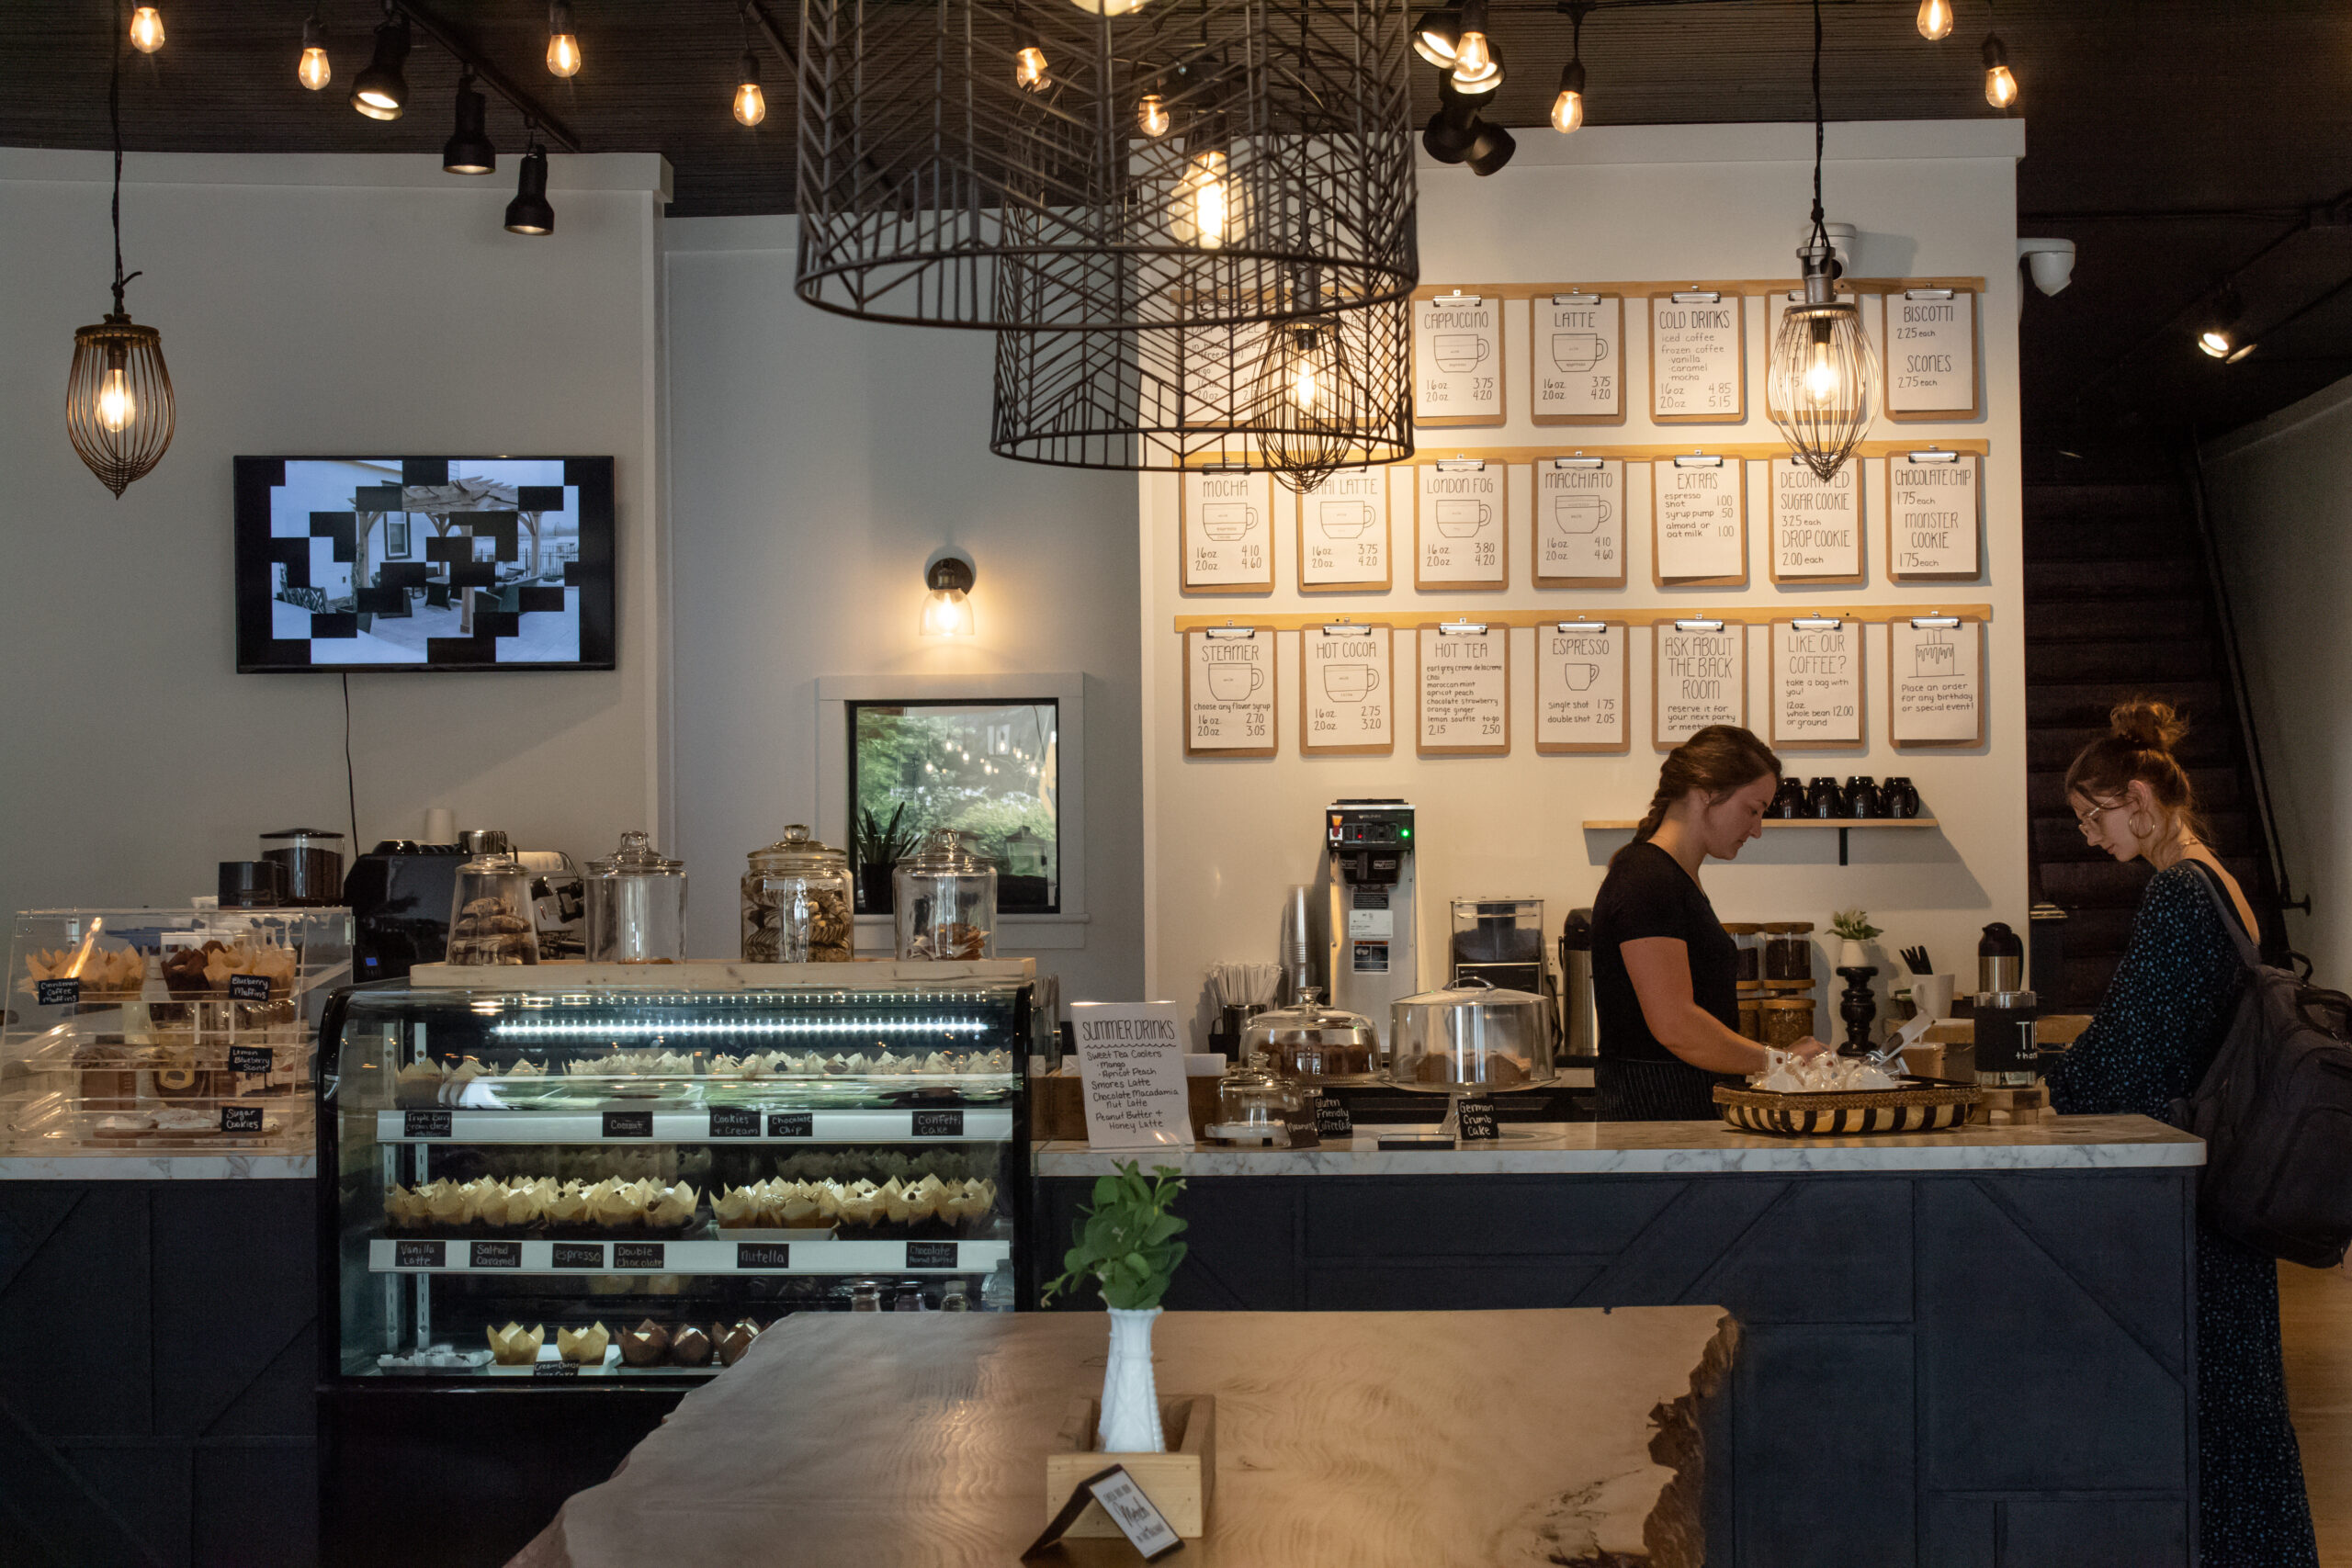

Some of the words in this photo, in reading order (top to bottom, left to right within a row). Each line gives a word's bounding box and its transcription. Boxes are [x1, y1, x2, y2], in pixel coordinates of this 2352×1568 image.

[1424, 310, 1488, 329] CAPPUCCINO
[1555, 312, 1595, 327] LATTE
[1659, 310, 1686, 329] COLD
[1691, 310, 1730, 329] DRINKS
[1904, 306, 1953, 322] BISCOTTI
[1661, 333, 1679, 342] iced
[1685, 332, 1714, 342] coffee
[1661, 344, 1690, 355] frozen
[1695, 344, 1724, 354] coffee
[1671, 355, 1701, 364] vanilla
[1907, 355, 1951, 373] SCONES
[1671, 363, 1707, 372] caramel
[1544, 472, 1612, 489] MACCHIATO
[1677, 472, 1718, 490] EXTRAS
[1895, 469, 1948, 486] CHOCOLATE
[1950, 469, 1971, 485] CHIP
[1203, 479, 1248, 497] MOCHA
[1340, 478, 1377, 495] LATTE
[1427, 478, 1470, 493] LONDON
[1473, 478, 1493, 493] FOG
[1664, 493, 1701, 502] espresso
[1781, 493, 1813, 510] SUGAR
[1815, 493, 1850, 510] COOKIE
[1666, 511, 1690, 521] syrup
[1692, 510, 1714, 518] pump
[1905, 512, 1959, 529] MONSTER
[1666, 521, 1696, 529] almond
[1667, 530, 1682, 538] oat
[1684, 529, 1702, 537] milk
[1782, 530, 1812, 547] DROP
[1815, 530, 1850, 547] COOKIE
[1911, 532, 1949, 548] COOKIE
[1553, 638, 1609, 655] ESPRESSO
[1665, 637, 1689, 657] ASK
[1692, 636, 1734, 657] ABOUT
[1788, 635, 1815, 652] LIKE
[1821, 634, 1845, 652] OUR
[1202, 645, 1259, 661] STEAMER
[1317, 642, 1339, 659] HOT
[1342, 641, 1376, 658] COCOA
[1435, 642, 1459, 658] HOT
[1464, 642, 1487, 658] TEA
[1441, 666, 1453, 674] grey
[1668, 657, 1696, 677] THE
[1698, 657, 1733, 678] BACK
[1790, 655, 1847, 674] COFFEE?
[1682, 680, 1720, 699] ROOM
[1815, 679, 1829, 689] bag
[1901, 683, 1924, 693] Place
[1454, 690, 1474, 698] peach
[1918, 695, 1935, 704] any
[1937, 694, 1973, 702] birthday
[1461, 698, 1498, 706] strawberry
[1548, 700, 1570, 713] single
[1573, 700, 1589, 709] shot
[1193, 703, 1216, 711] choose
[1218, 705, 1231, 713] any
[1252, 704, 1271, 712] syrup
[1427, 706, 1451, 716] orange
[1453, 707, 1475, 716] ginger
[1916, 703, 1944, 713] special
[1547, 715, 1572, 723] double
[1574, 715, 1590, 723] shot
[1668, 715, 1688, 723] your
[1797, 719, 1827, 729] ground
[232, 976, 268, 990] Blueberry
[234, 987, 266, 999] Muffins
[1082, 1020, 1133, 1042] SUMMER
[1135, 1020, 1175, 1040] DRINKS
[1087, 1050, 1112, 1061] Sweet
[1113, 1050, 1129, 1058] Tea
[1130, 1049, 1162, 1058] Coolers
[234, 1056, 270, 1067] Blueberry
[1100, 1061, 1126, 1072] Mango
[1102, 1068, 1131, 1079] Apricot
[1132, 1067, 1157, 1077] Peach
[1091, 1080, 1125, 1091] Smores
[1127, 1078, 1151, 1088] Latte
[1092, 1091, 1132, 1102] Chocolate
[1132, 1089, 1180, 1098] Macadamia
[1126, 1099, 1148, 1108] Latte
[1315, 1097, 1340, 1109] Gluten
[1459, 1101, 1494, 1113] German
[227, 1109, 256, 1122] Sugar
[713, 1113, 749, 1124] Cookies
[772, 1116, 812, 1125] Chocolate
[918, 1114, 961, 1125] Confetti
[1095, 1111, 1125, 1122] Peanut
[1125, 1111, 1153, 1120] Butter
[1316, 1108, 1350, 1122] Friendly
[1463, 1114, 1492, 1124] Crumb
[226, 1120, 259, 1129] Cookies
[921, 1125, 947, 1135] Cake
[1109, 1122, 1136, 1134] Honey
[1139, 1119, 1164, 1129] Latte
[725, 1126, 758, 1135] Cream
[779, 1126, 803, 1135] Chip
[1467, 1125, 1491, 1136] Cake
[401, 1245, 435, 1255] Vanilla
[477, 1244, 508, 1256] Salted
[618, 1247, 653, 1257] Double
[910, 1245, 950, 1255] Chocolate
[403, 1256, 431, 1266] Latte
[476, 1255, 515, 1266] Caramel
[616, 1258, 662, 1267] Chocolate
